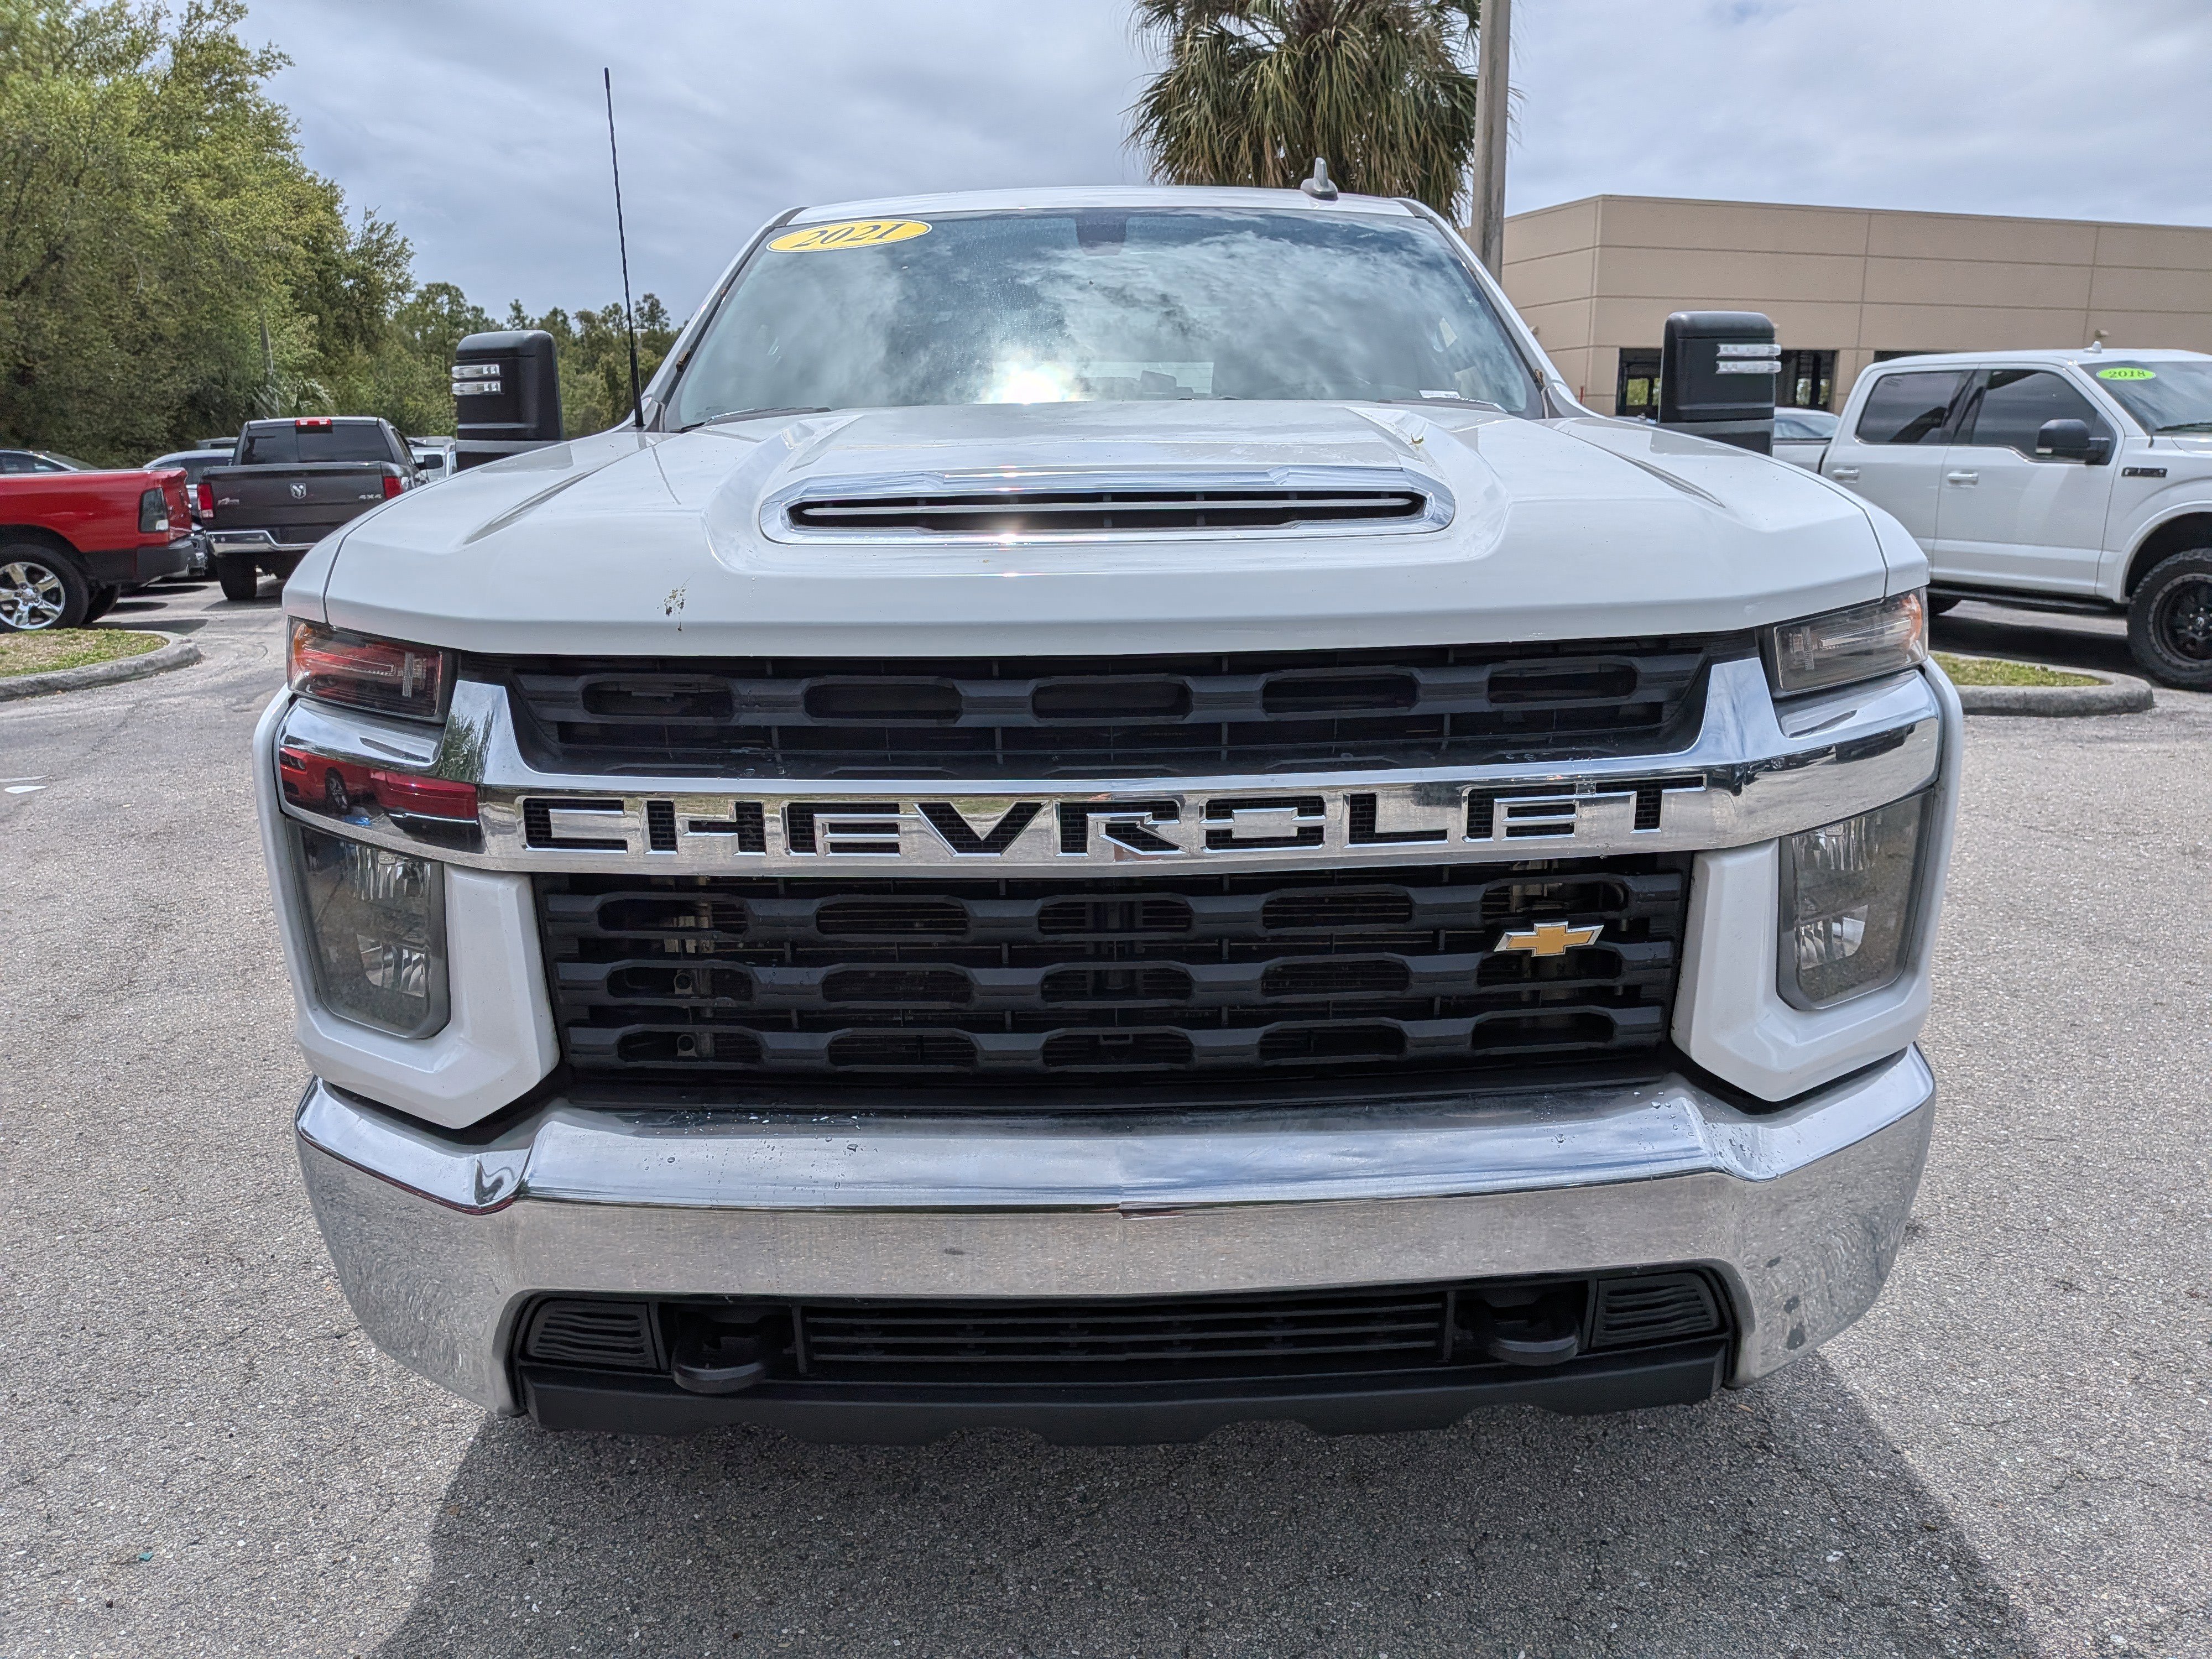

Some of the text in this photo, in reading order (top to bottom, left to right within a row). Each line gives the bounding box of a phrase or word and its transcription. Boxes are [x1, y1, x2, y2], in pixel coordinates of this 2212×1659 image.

[789, 222, 907, 249] 2021
[2108, 370, 2146, 378] 2018
[519, 775, 1704, 855] CHEVROLET
